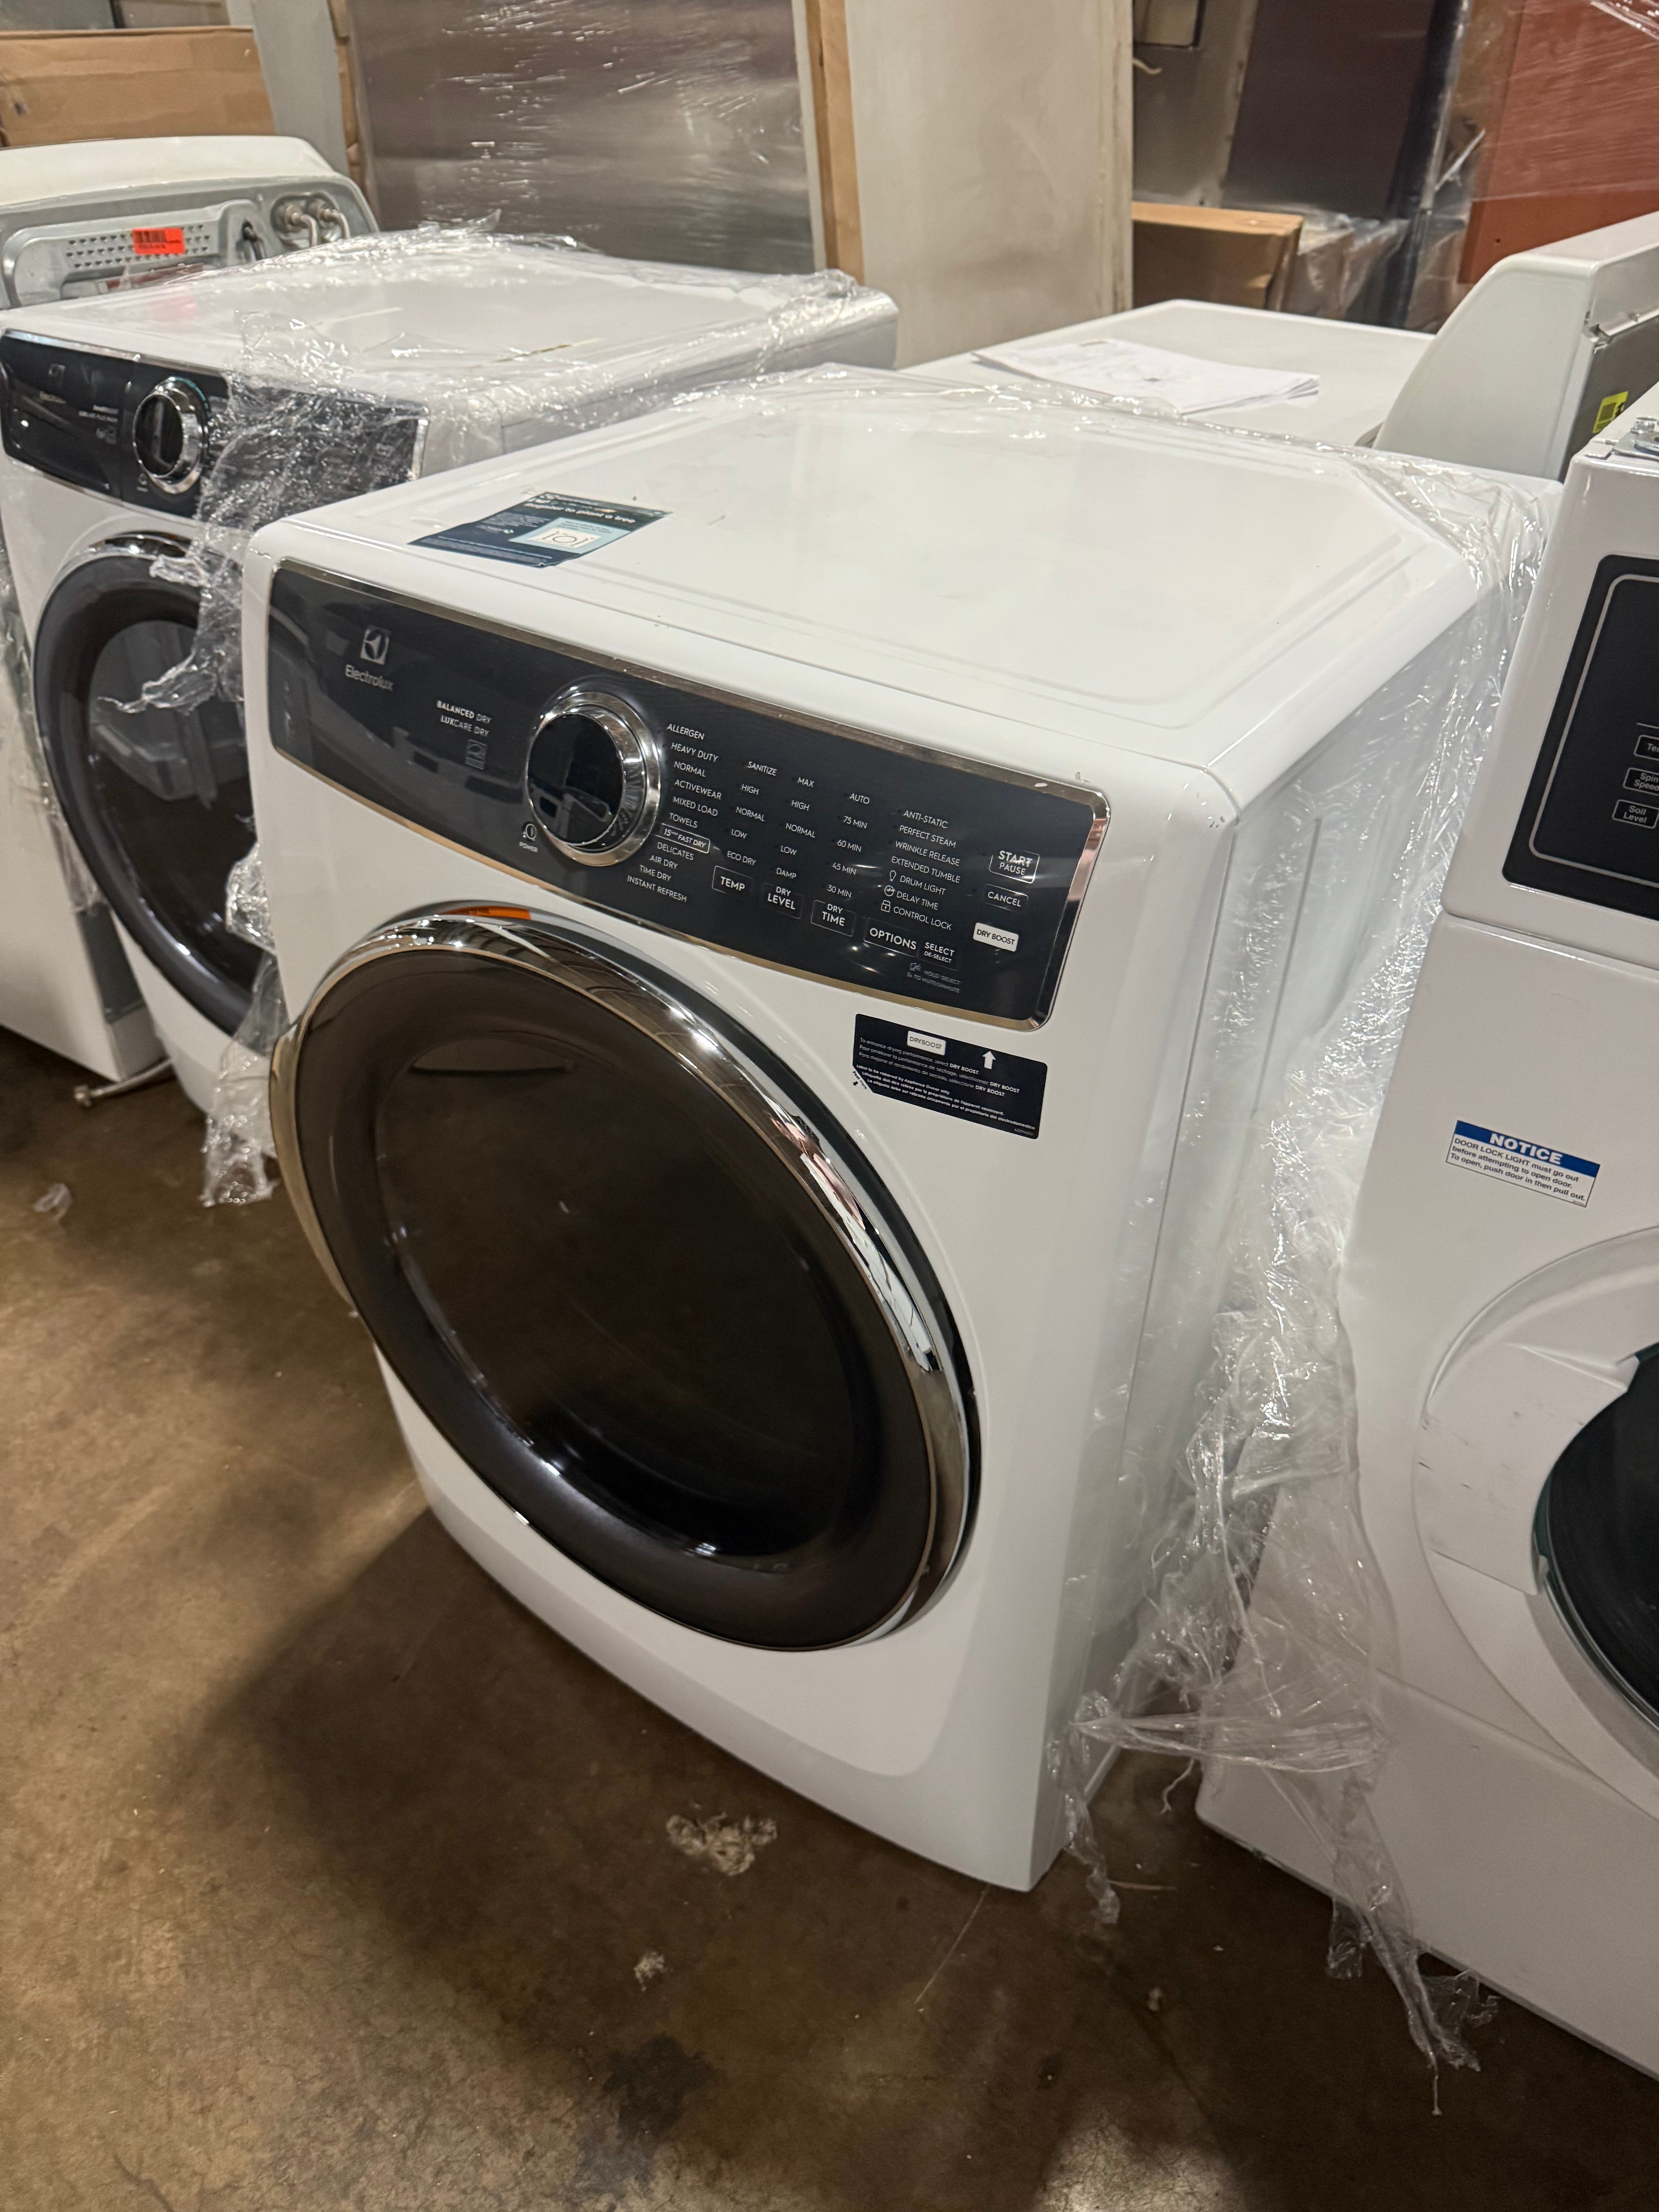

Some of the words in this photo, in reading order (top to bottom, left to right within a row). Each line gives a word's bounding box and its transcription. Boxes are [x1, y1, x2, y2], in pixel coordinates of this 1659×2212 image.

[345, 665, 394, 691] Electrolux
[436, 700, 474, 718] BALANCED
[476, 714, 491, 724] DRY
[440, 715, 472, 732] LUXCARE
[474, 726, 489, 737] DRY
[667, 724, 704, 740] ALLERGEN
[672, 743, 696, 755] HEAVY
[697, 750, 718, 762] DUTY
[1647, 743, 1659, 752] Te
[674, 761, 706, 777] NORMAL
[748, 761, 777, 776] SANITIZE
[798, 777, 814, 787] MAX
[1640, 773, 1658, 783] Spin
[675, 779, 721, 800] ACTIVEWEAR
[742, 784, 759, 795] HIGH
[792, 800, 809, 811] HIGH
[849, 793, 869, 804] AUTO
[673, 797, 696, 809] MIXED
[697, 804, 718, 816] LOAD
[736, 807, 764, 821] NORMAL
[1629, 805, 1646, 816] Soil
[669, 813, 697, 828] TOWELS
[844, 816, 852, 824] 75
[853, 819, 867, 828] MIN
[903, 811, 948, 828] ANTI-STATIC
[1623, 812, 1647, 823] Level
[732, 829, 747, 838] LOW
[786, 823, 815, 838] NORMAL
[899, 825, 930, 839] PERFECT
[931, 835, 956, 848] STEAM
[678, 835, 693, 843] FAST
[693, 840, 706, 848] DRY
[848, 843, 861, 852] MIN
[658, 842, 694, 860] DELICATES
[781, 845, 797, 855] LOW
[896, 841, 927, 856] WRINKLE
[929, 851, 960, 866] RELEASE
[649, 855, 662, 863] AIR
[664, 859, 678, 869] DRY
[727, 851, 741, 860] ECO
[743, 856, 756, 866] DRY
[998, 850, 1032, 867] START
[640, 865, 656, 876] TIME
[657, 872, 671, 881] DRY
[776, 867, 796, 879] DAMP
[842, 866, 856, 875] MIN
[891, 856, 929, 873] EXTENDED
[932, 868, 960, 883] TUMBLE
[1000, 862, 1026, 875] PAUSE
[627, 876, 656, 890] INSTANT
[658, 886, 687, 902] REFRESH
[721, 876, 745, 891] TEMP
[776, 886, 791, 896] DRY
[900, 876, 922, 888] DRUM
[924, 883, 946, 895] LIGHT
[838, 888, 852, 898] MIN
[897, 891, 920, 903] DELAY
[922, 899, 938, 910] TIME
[988, 892, 1021, 907] CANCEL
[768, 893, 795, 909] LEVEL
[828, 904, 843, 914] DRY
[822, 911, 845, 926] TIME
[894, 907, 929, 923] CONTROL
[931, 919, 952, 930] LOCK
[870, 928, 916, 950] OPTIONS
[977, 929, 991, 938] DRY
[992, 934, 1015, 945] BOOST
[925, 942, 955, 956] SELECT
[924, 951, 952, 963] DE-SELECT
[961, 1066, 979, 1075] BOOST
[987, 1088, 1005, 1097] BOOST
[1001, 1085, 1020, 1093] BOOST
[1455, 1138, 1478, 1150] DOOR
[1480, 1146, 1504, 1158] LOCK
[1506, 1154, 1530, 1166] LIGHT
[1532, 1164, 1551, 1173] must
[1490, 1133, 1563, 1164] NOTICE
[1453, 1146, 1476, 1157] before
[1478, 1154, 1519, 1172] attempting
[1531, 1172, 1550, 1181] open
[1553, 1178, 1572, 1188] door.
[1462, 1158, 1482, 1168] open,
[1484, 1165, 1503, 1174] push
[1505, 1172, 1523, 1180] door
[1535, 1181, 1551, 1190] then
[1553, 1187, 1568, 1195] pull
